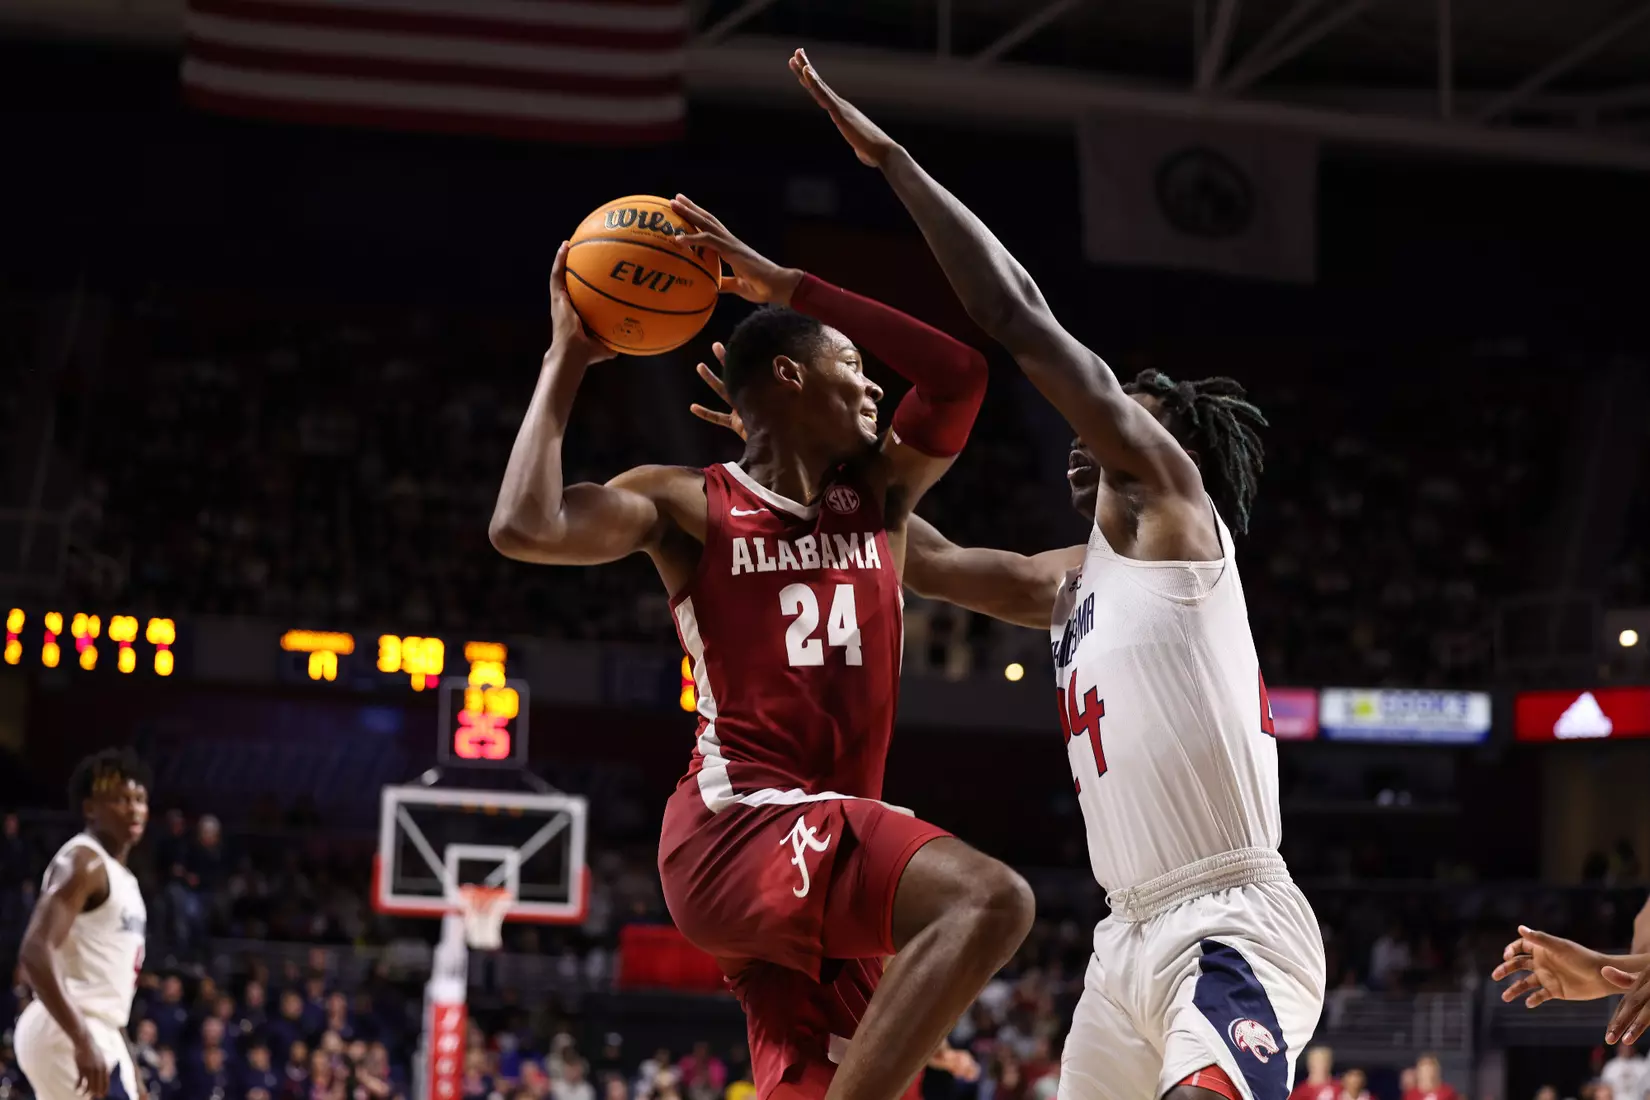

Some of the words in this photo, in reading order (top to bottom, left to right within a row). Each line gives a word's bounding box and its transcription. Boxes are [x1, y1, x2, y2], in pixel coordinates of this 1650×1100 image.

[827, 489, 858, 511] SEC
[731, 532, 882, 575] ALABAMA
[778, 584, 863, 666] 24
[780, 815, 831, 898] A
